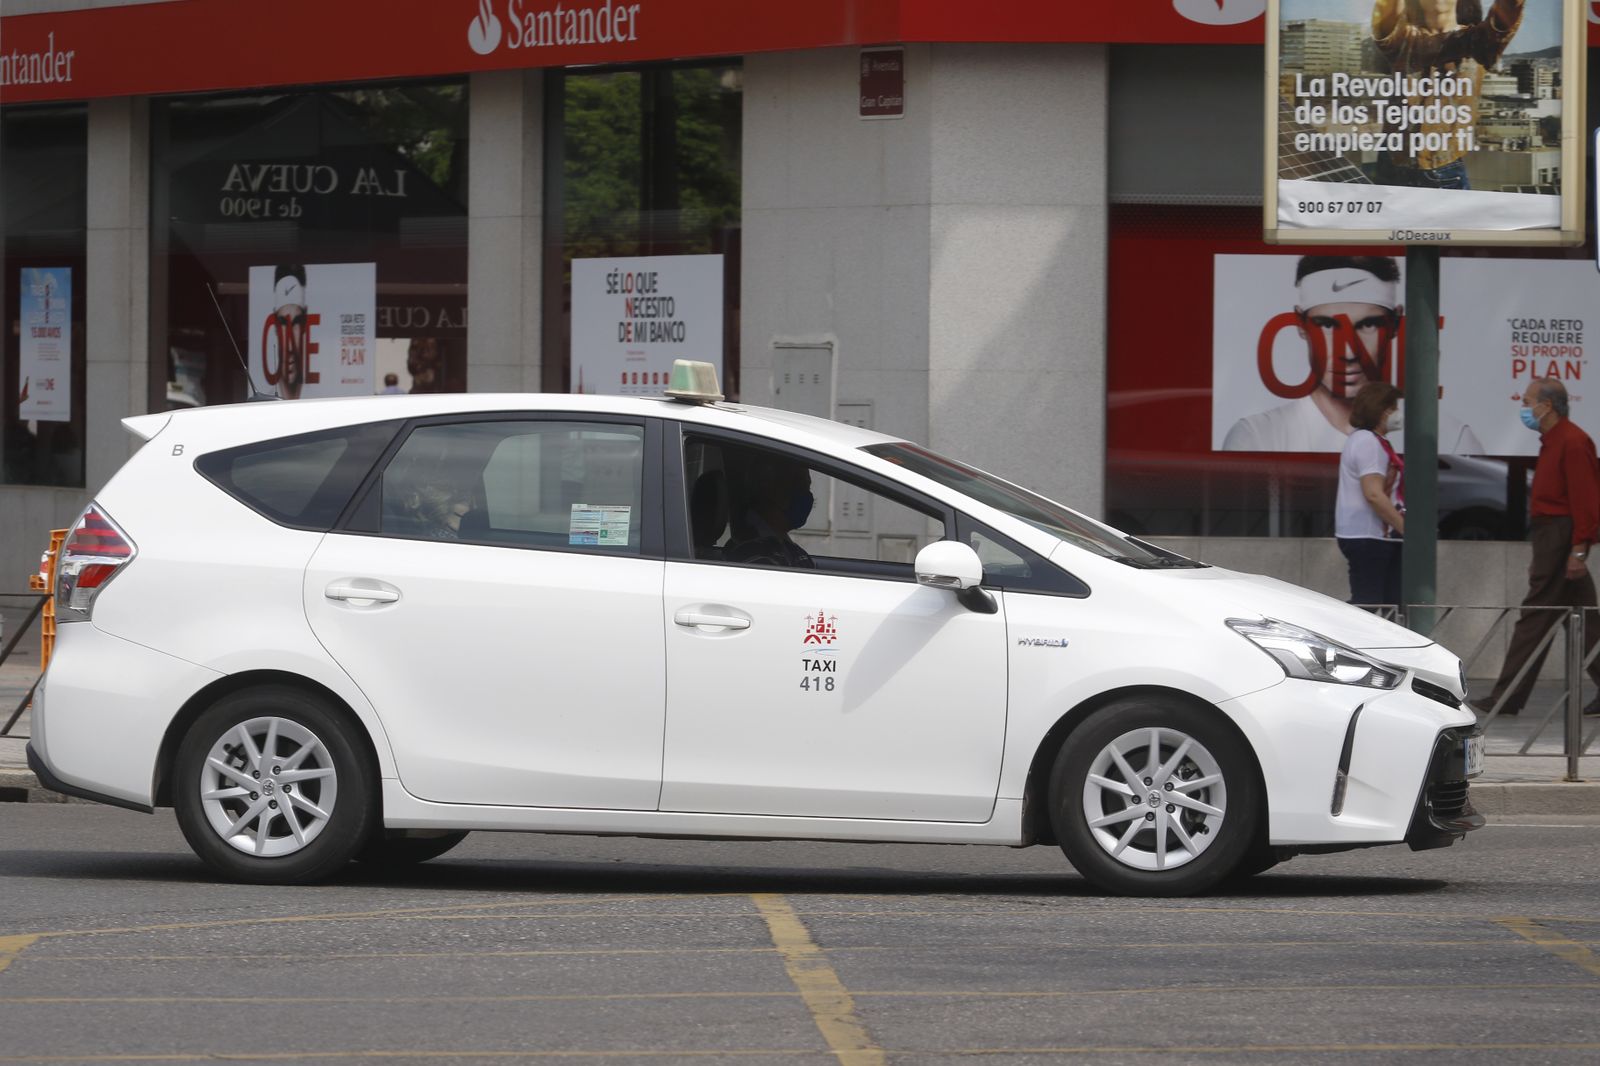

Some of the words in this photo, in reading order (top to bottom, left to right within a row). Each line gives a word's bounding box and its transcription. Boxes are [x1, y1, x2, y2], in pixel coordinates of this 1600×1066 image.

[507, 0, 641, 49] Santander
[1295, 73, 1326, 97] La
[1331, 71, 1473, 97] Revolución
[1294, 99, 1326, 124] de
[1331, 99, 1369, 124] los
[1372, 99, 1472, 130] Tejados
[1294, 126, 1404, 158] empieza
[1409, 132, 1453, 158] por
[1455, 126, 1480, 152] ti.
[1298, 201, 1323, 214] 900
[1328, 201, 1343, 214] 67
[1347, 201, 1363, 214] 07
[1366, 201, 1383, 214] 07
[1388, 230, 1451, 241] JCDecaux
[606, 267, 619, 294] SÉ
[620, 272, 634, 294] LO
[636, 272, 659, 295] QUE
[625, 296, 675, 319] NECESITO
[618, 321, 632, 343] DE
[634, 321, 648, 343] MI
[649, 321, 686, 343] BANCO
[1550, 319, 1584, 331] RETO
[1511, 331, 1584, 344] REQUIERE
[262, 313, 321, 386] ONE
[1257, 312, 1445, 400] ON
[1511, 345, 1529, 357] SU
[1532, 345, 1583, 358] PROPIO
[171, 444, 185, 457] B
[802, 659, 837, 672] TAXI
[799, 676, 836, 692] 418
